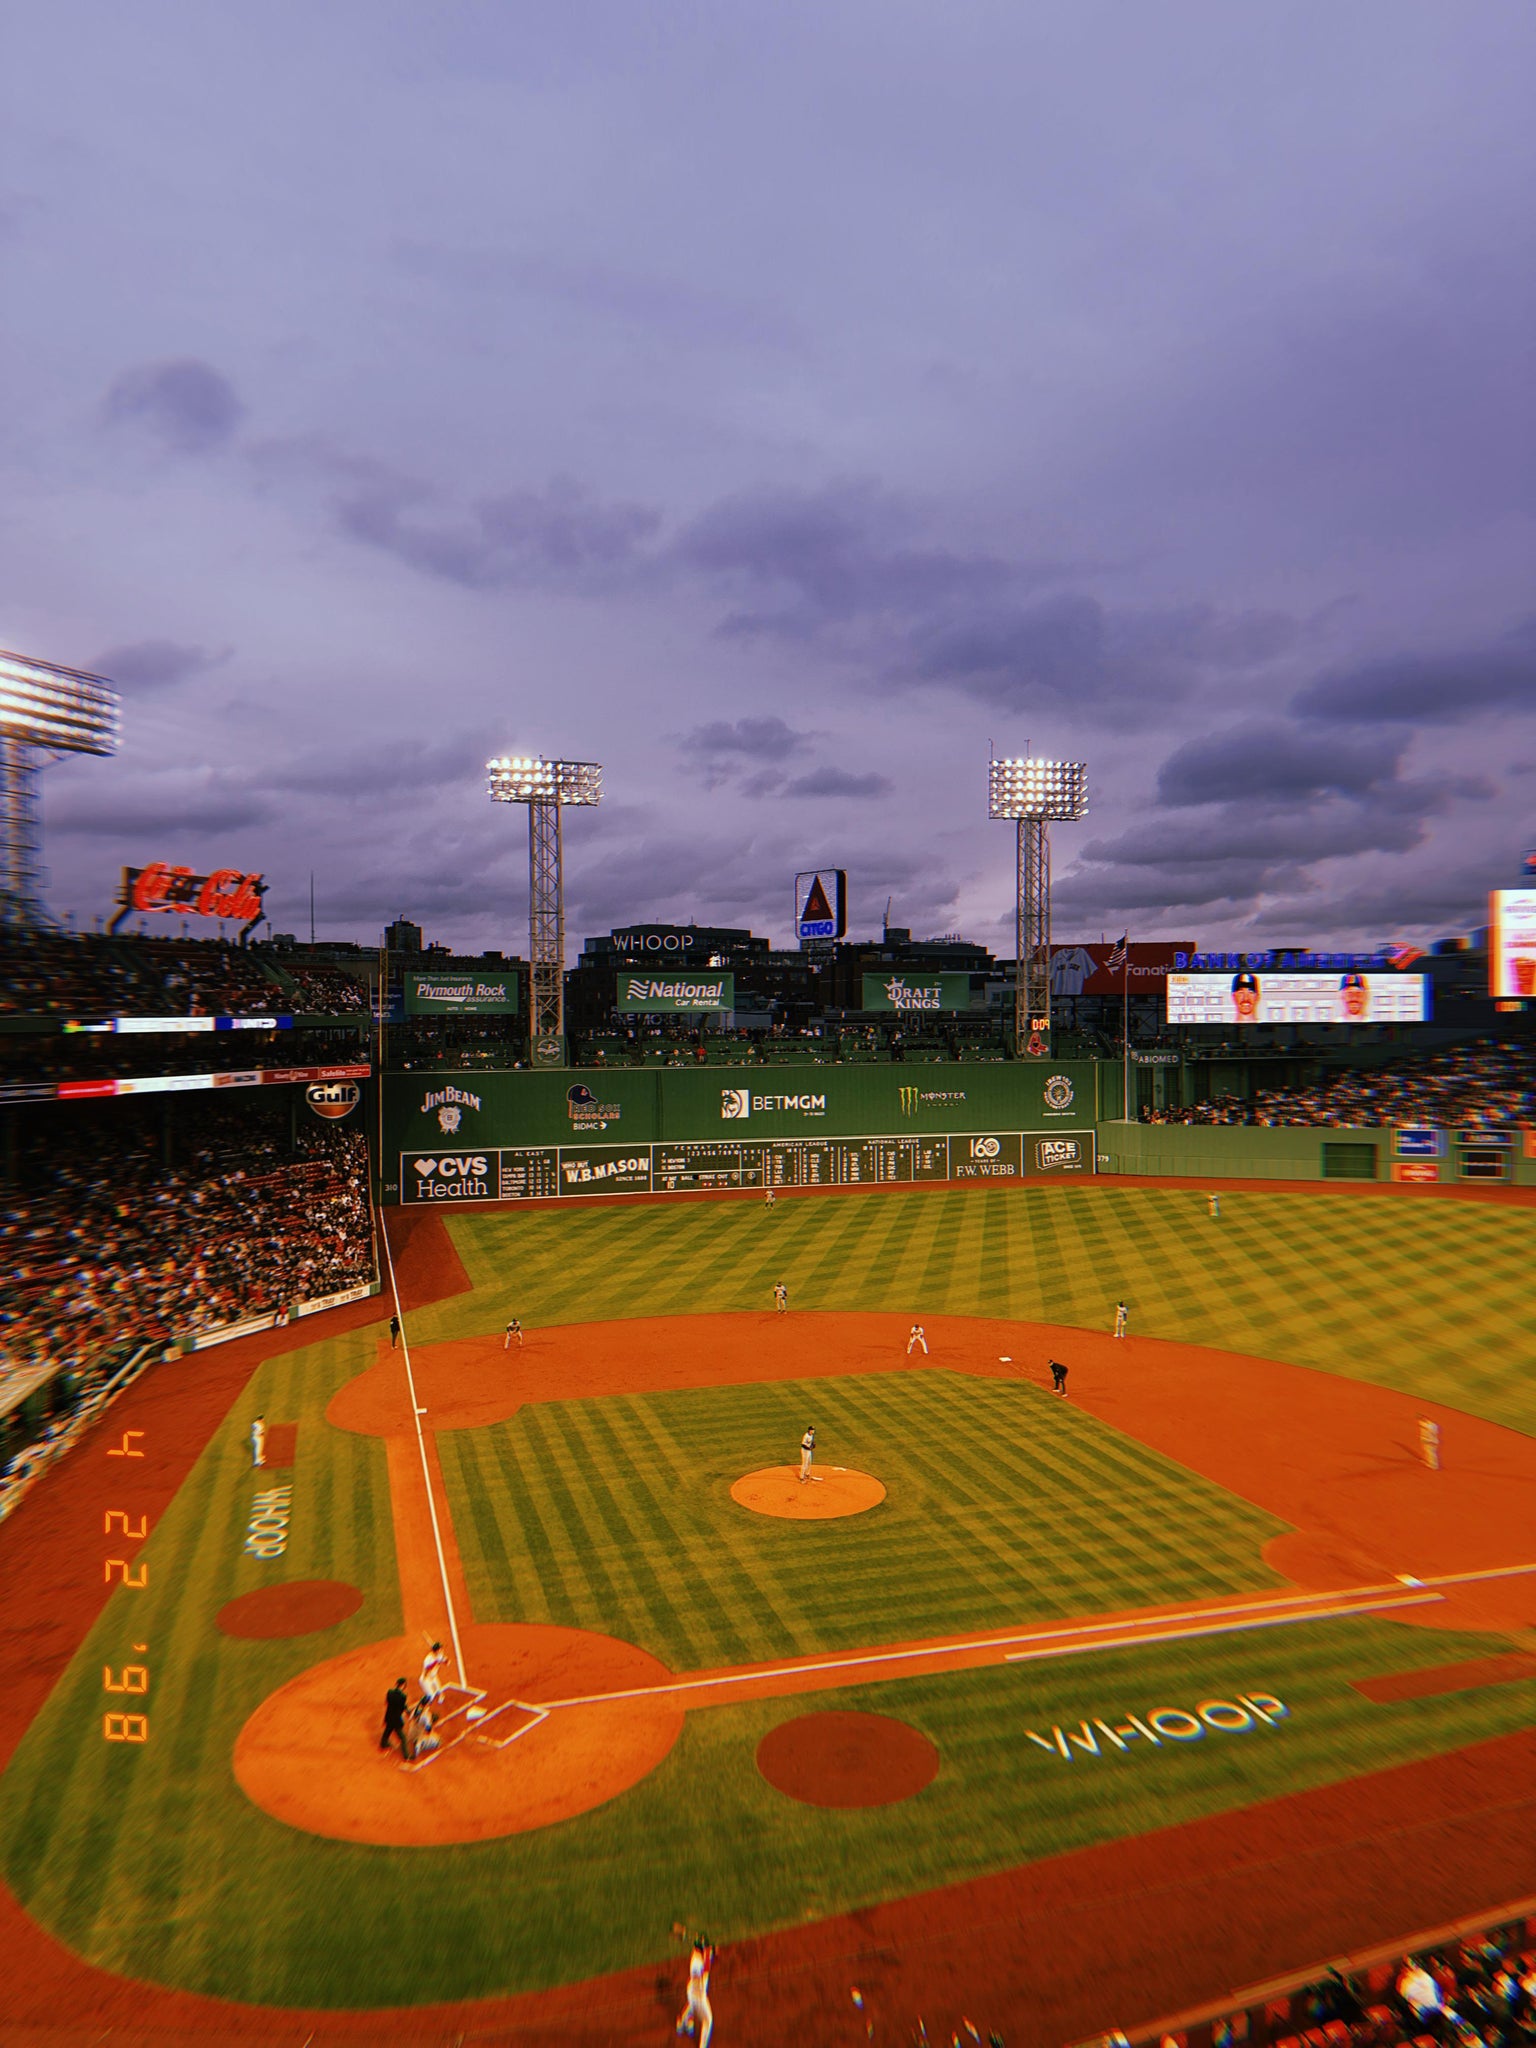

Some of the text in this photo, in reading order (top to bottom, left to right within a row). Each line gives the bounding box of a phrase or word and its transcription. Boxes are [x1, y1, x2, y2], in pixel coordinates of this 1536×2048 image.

[800, 921, 833, 936] CITGO
[613, 935, 694, 950] WHOOP
[1174, 952, 1240, 968] BANK
[416, 984, 507, 998] Plymouth Rock
[650, 981, 724, 998] National
[887, 986, 941, 1000] DRAFT
[692, 998, 720, 1006] Rental
[894, 999, 941, 1008] KINGS
[1138, 1055, 1179, 1064] ABIOMED
[421, 1086, 482, 1113] JIM BEAM
[753, 1095, 826, 1110] BETMGM
[920, 1092, 966, 1100] MONSTER
[574, 1104, 621, 1112] RED SOX
[573, 1122, 598, 1130] BIDMC
[970, 1138, 1000, 1158] 160
[1044, 1142, 1076, 1155] ACE
[1045, 1152, 1076, 1163] TICKET
[438, 1156, 488, 1177] CVS
[956, 1164, 1014, 1177] F.W. WEBB
[416, 1178, 488, 1198] Health
[242, 1484, 294, 1561] WHOOP
[1024, 1691, 1291, 1762] WHOOP
